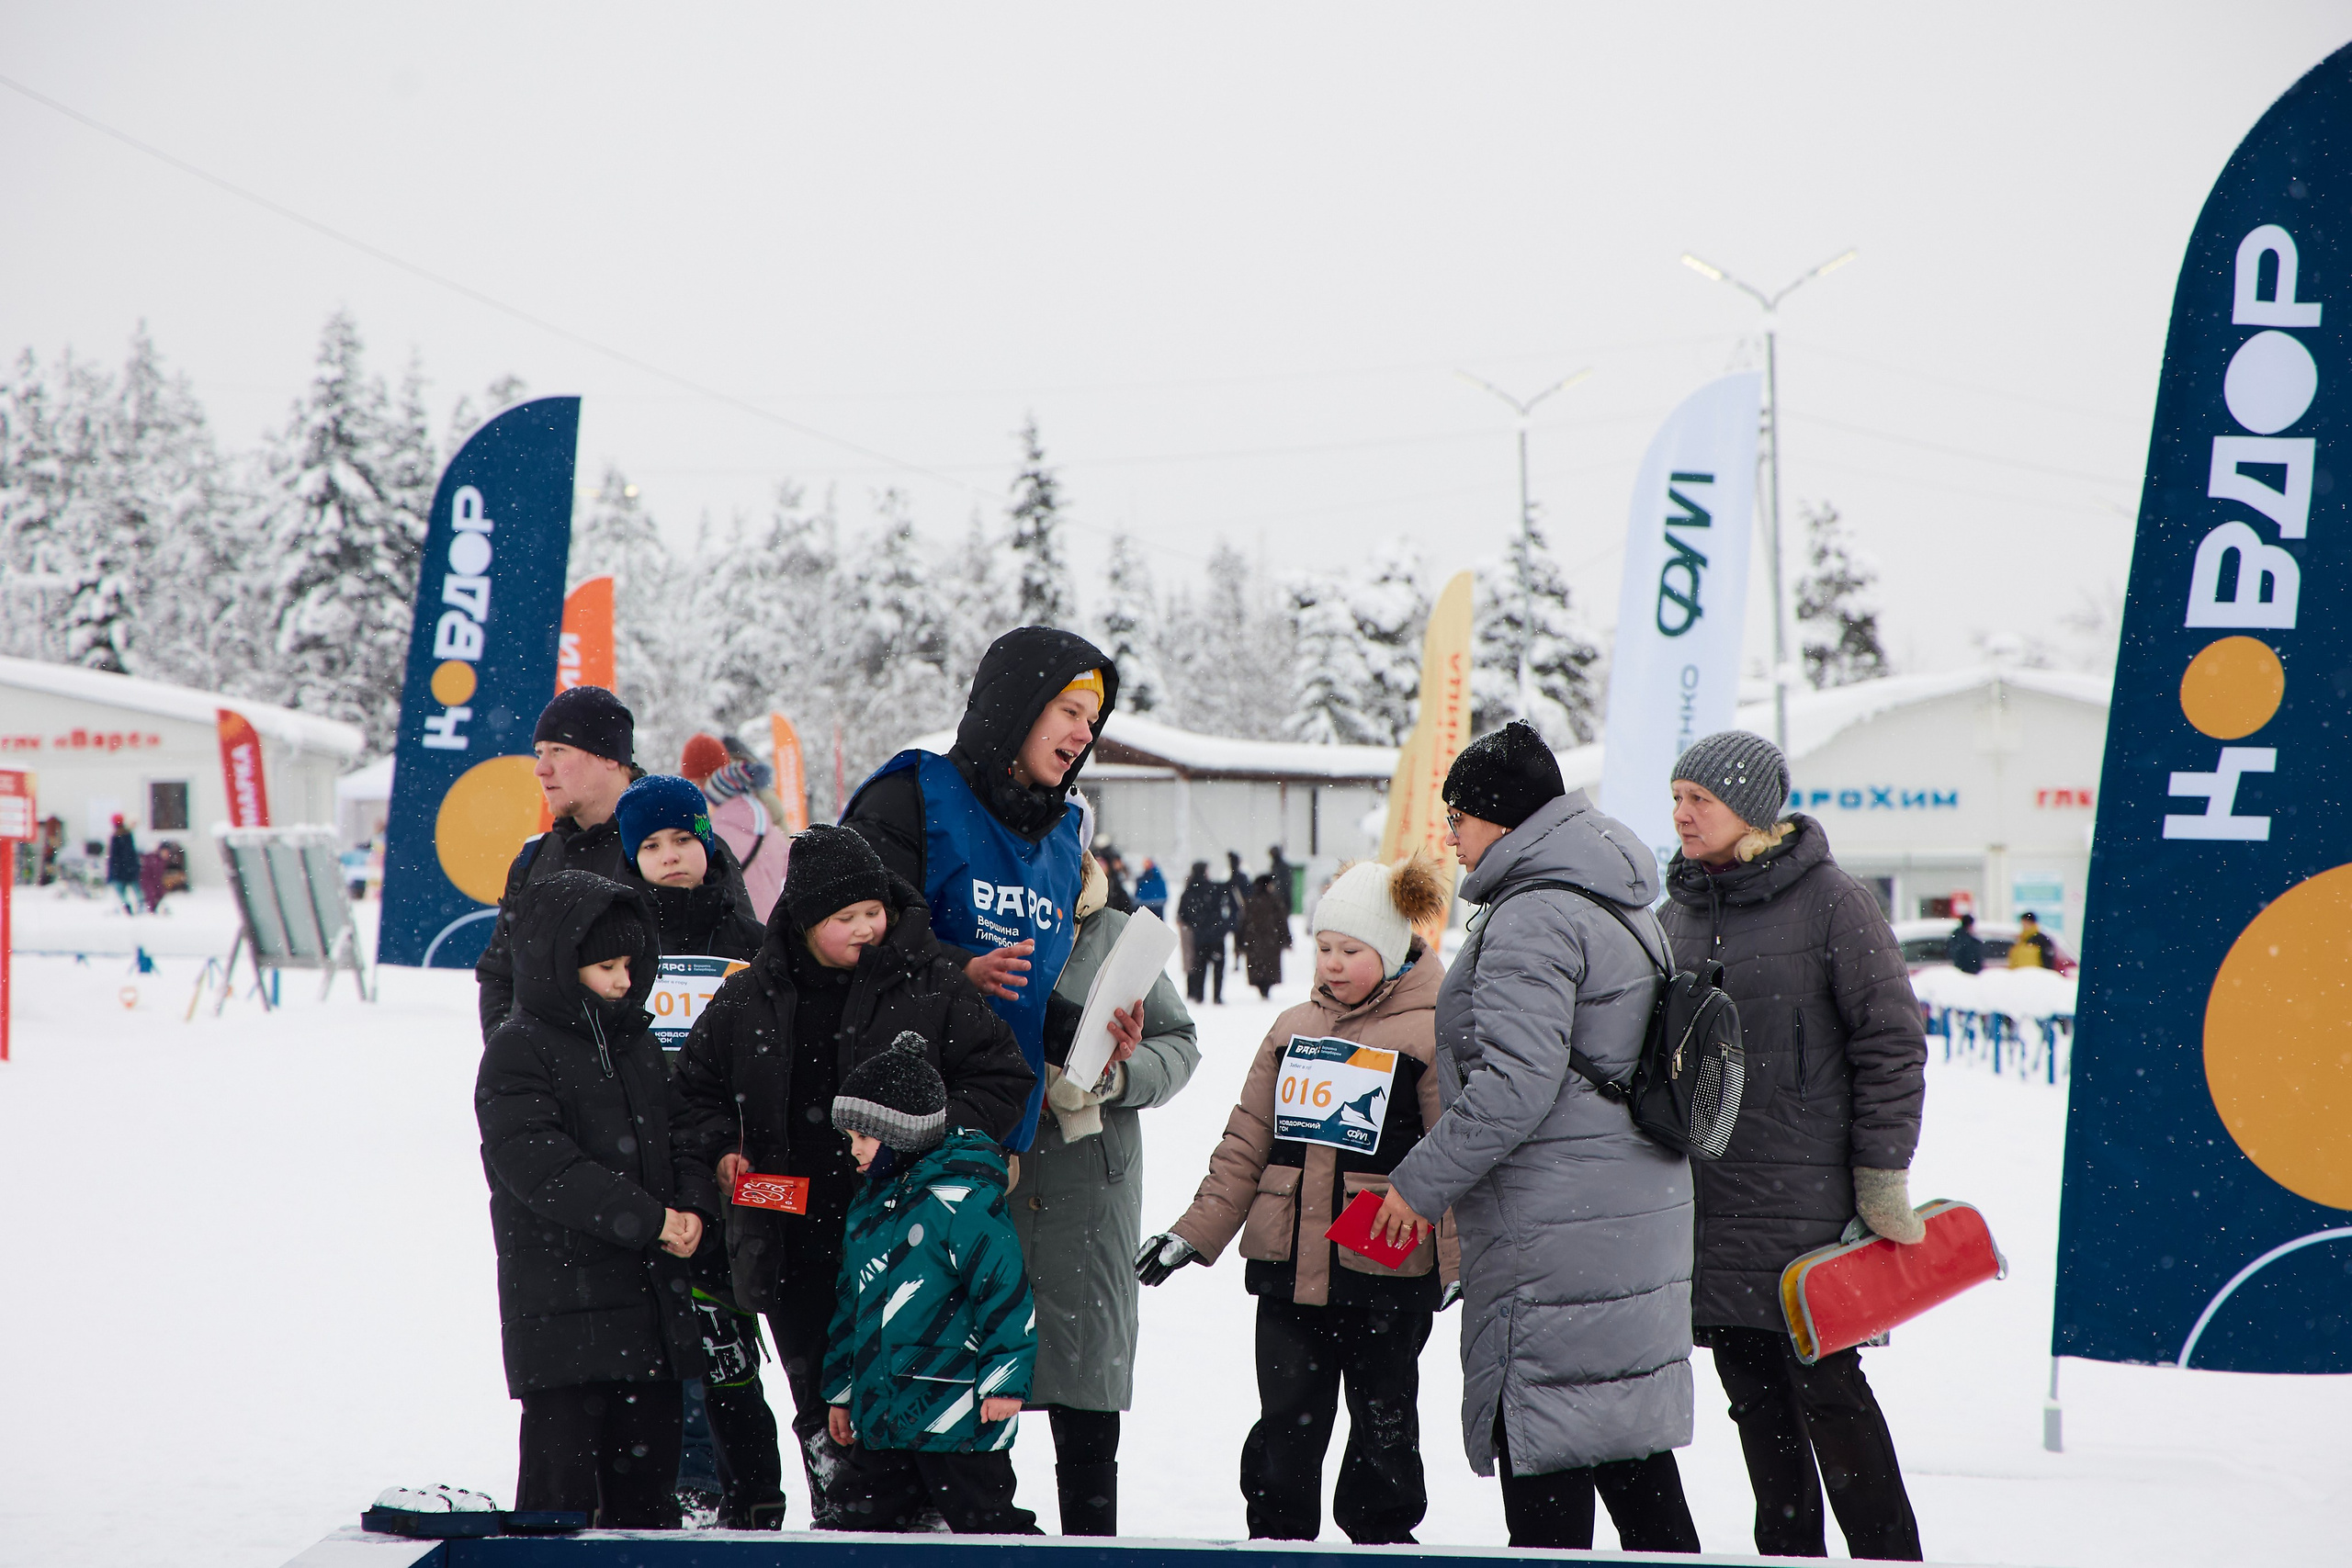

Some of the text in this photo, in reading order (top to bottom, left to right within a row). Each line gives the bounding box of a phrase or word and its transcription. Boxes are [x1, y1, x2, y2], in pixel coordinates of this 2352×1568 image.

[973, 878, 1053, 931] ВАРС
[977, 914, 1020, 937] Вершина
[659, 963, 685, 972] АРС
[1282, 1076, 1332, 1108] 016
